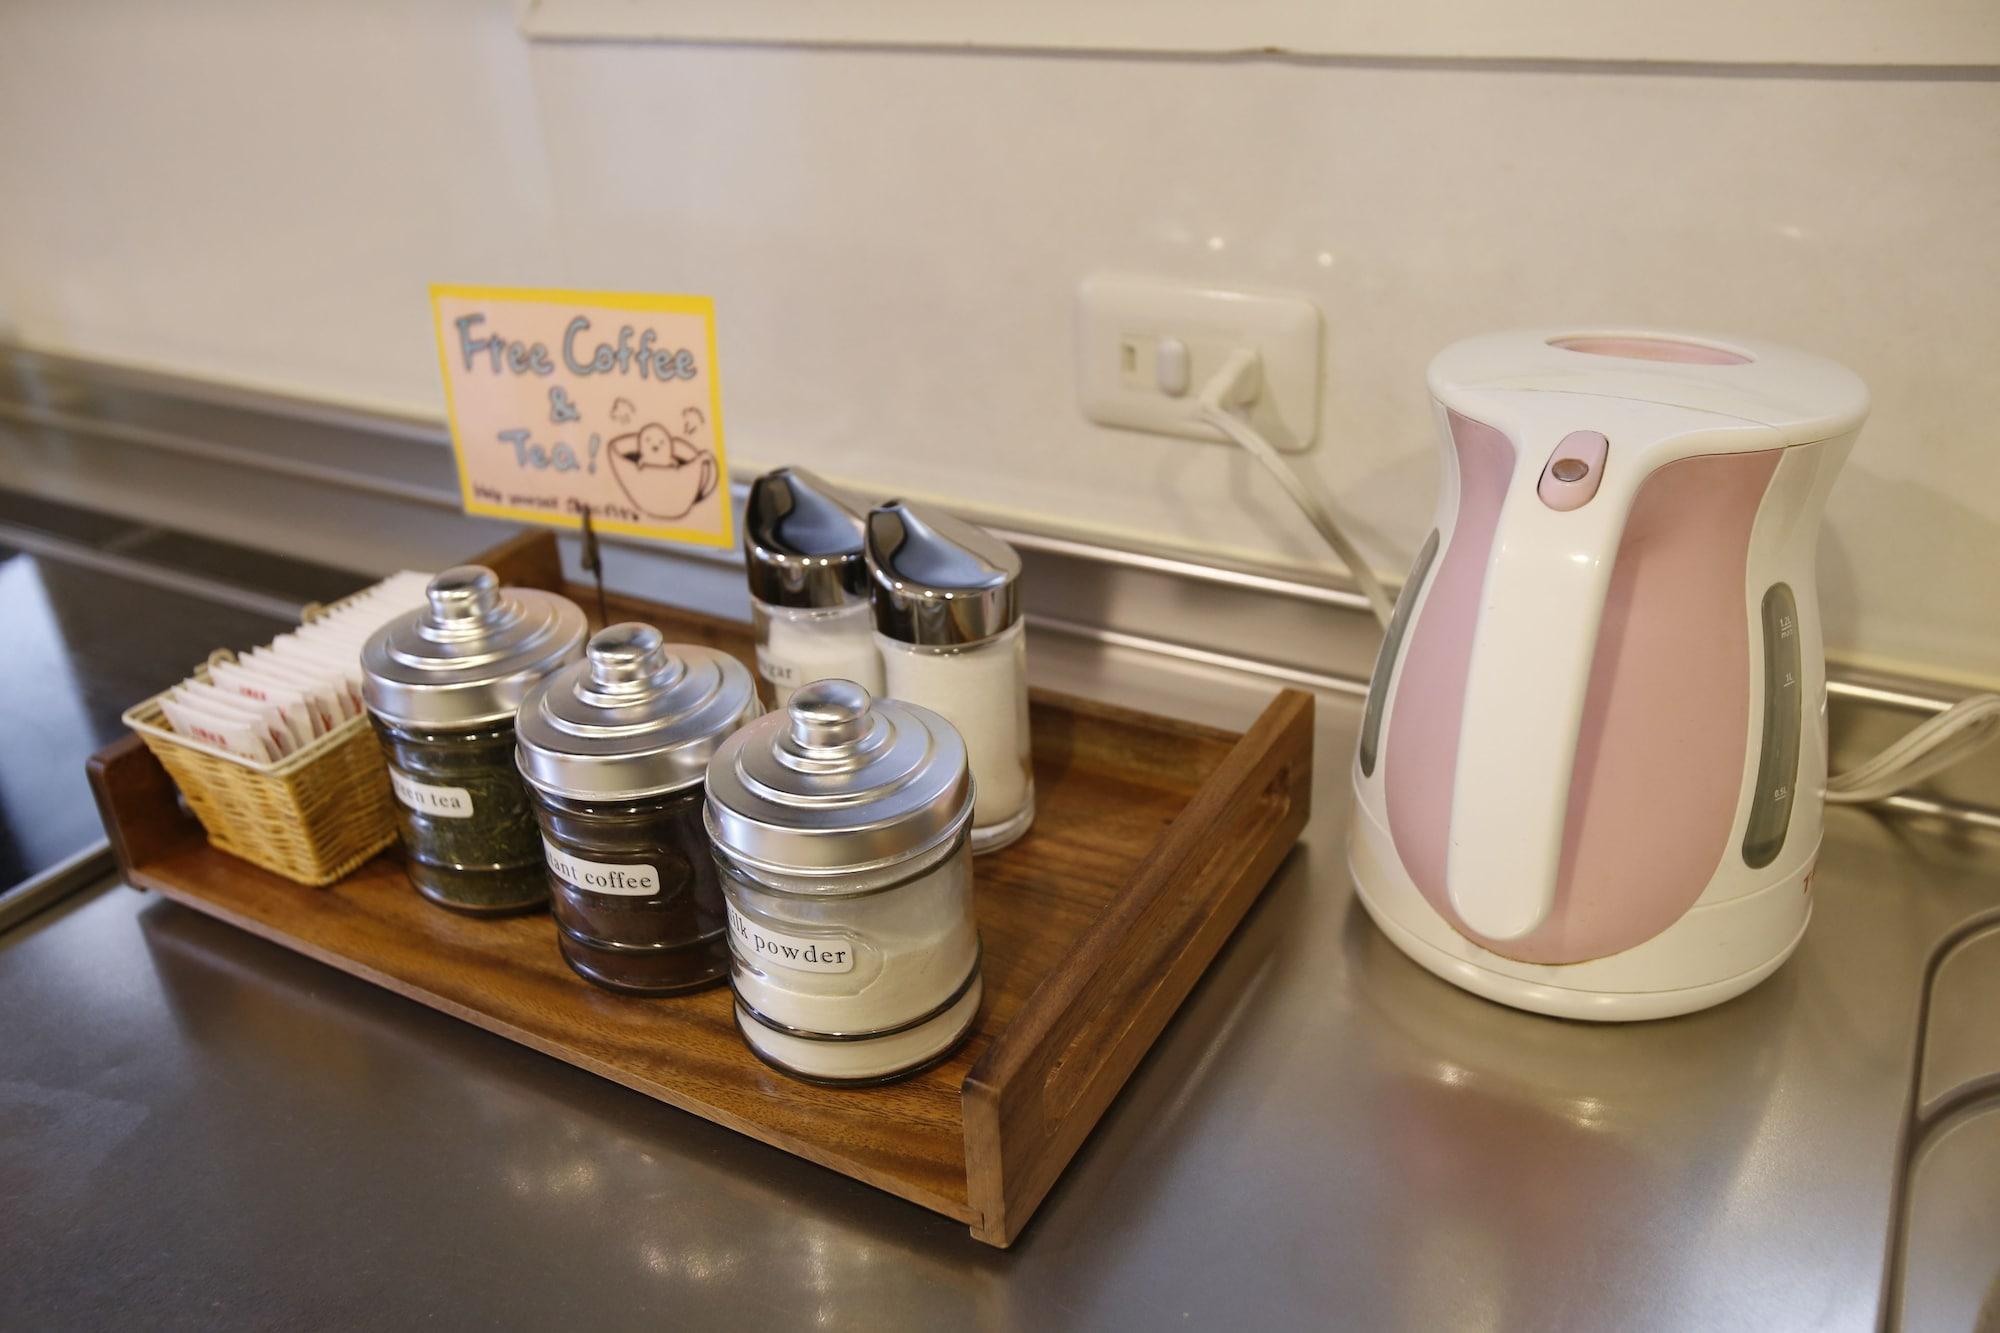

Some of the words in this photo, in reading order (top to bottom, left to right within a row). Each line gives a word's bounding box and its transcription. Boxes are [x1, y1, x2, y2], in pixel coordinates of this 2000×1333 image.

[455, 312, 555, 376] Free
[562, 315, 698, 382] Coffee
[547, 385, 581, 423] &
[497, 428, 602, 475] Tea!
[430, 791, 461, 809] tea
[584, 870, 652, 889] coffee
[753, 933, 847, 964] powder
